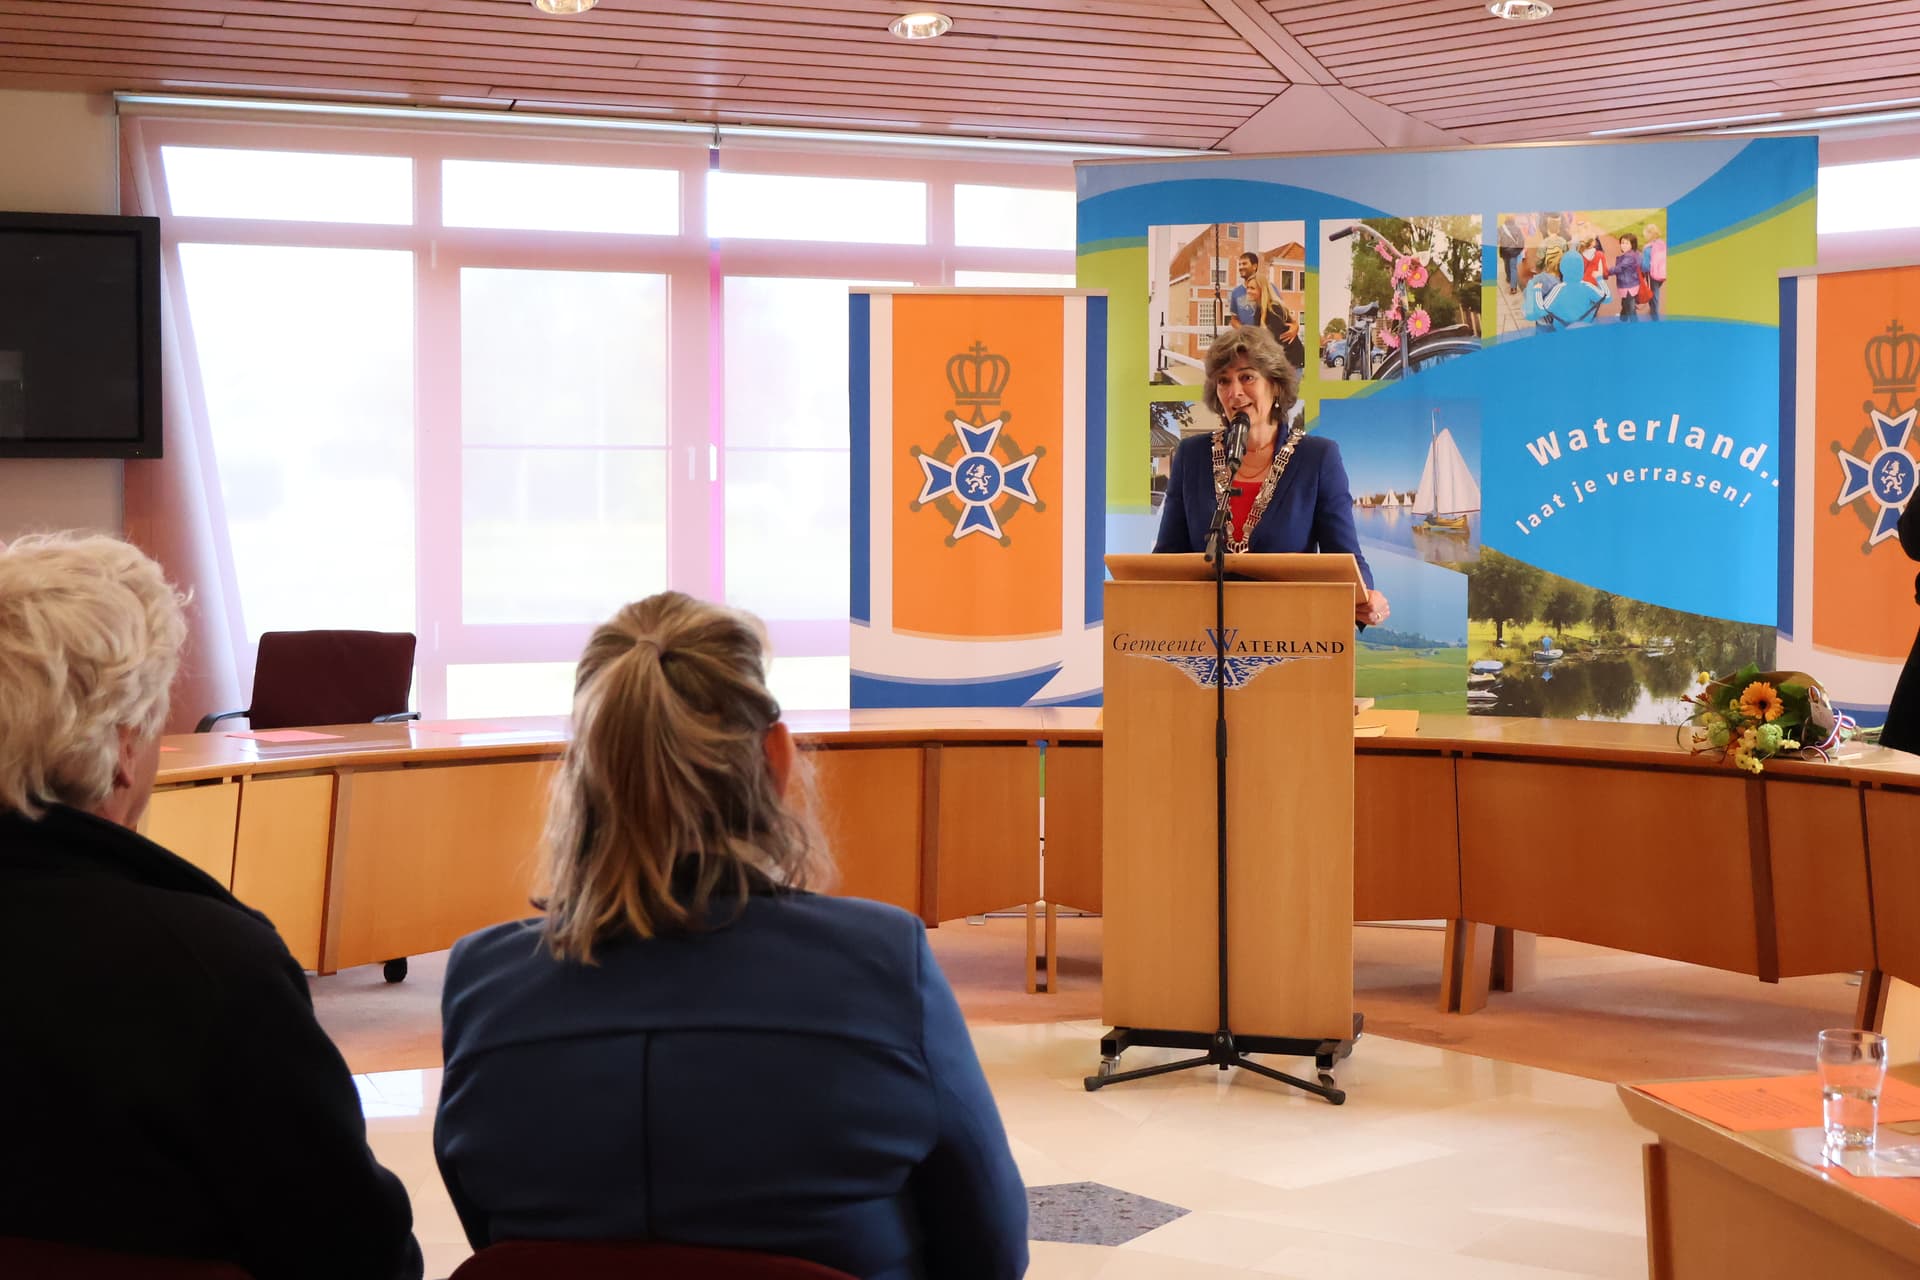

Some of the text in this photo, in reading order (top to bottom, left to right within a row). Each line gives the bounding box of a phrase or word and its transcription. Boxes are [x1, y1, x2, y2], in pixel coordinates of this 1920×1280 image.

[1515, 467, 1752, 535] laat je verrassen!
[1112, 628, 1345, 654] Gemeente WATERLAND
